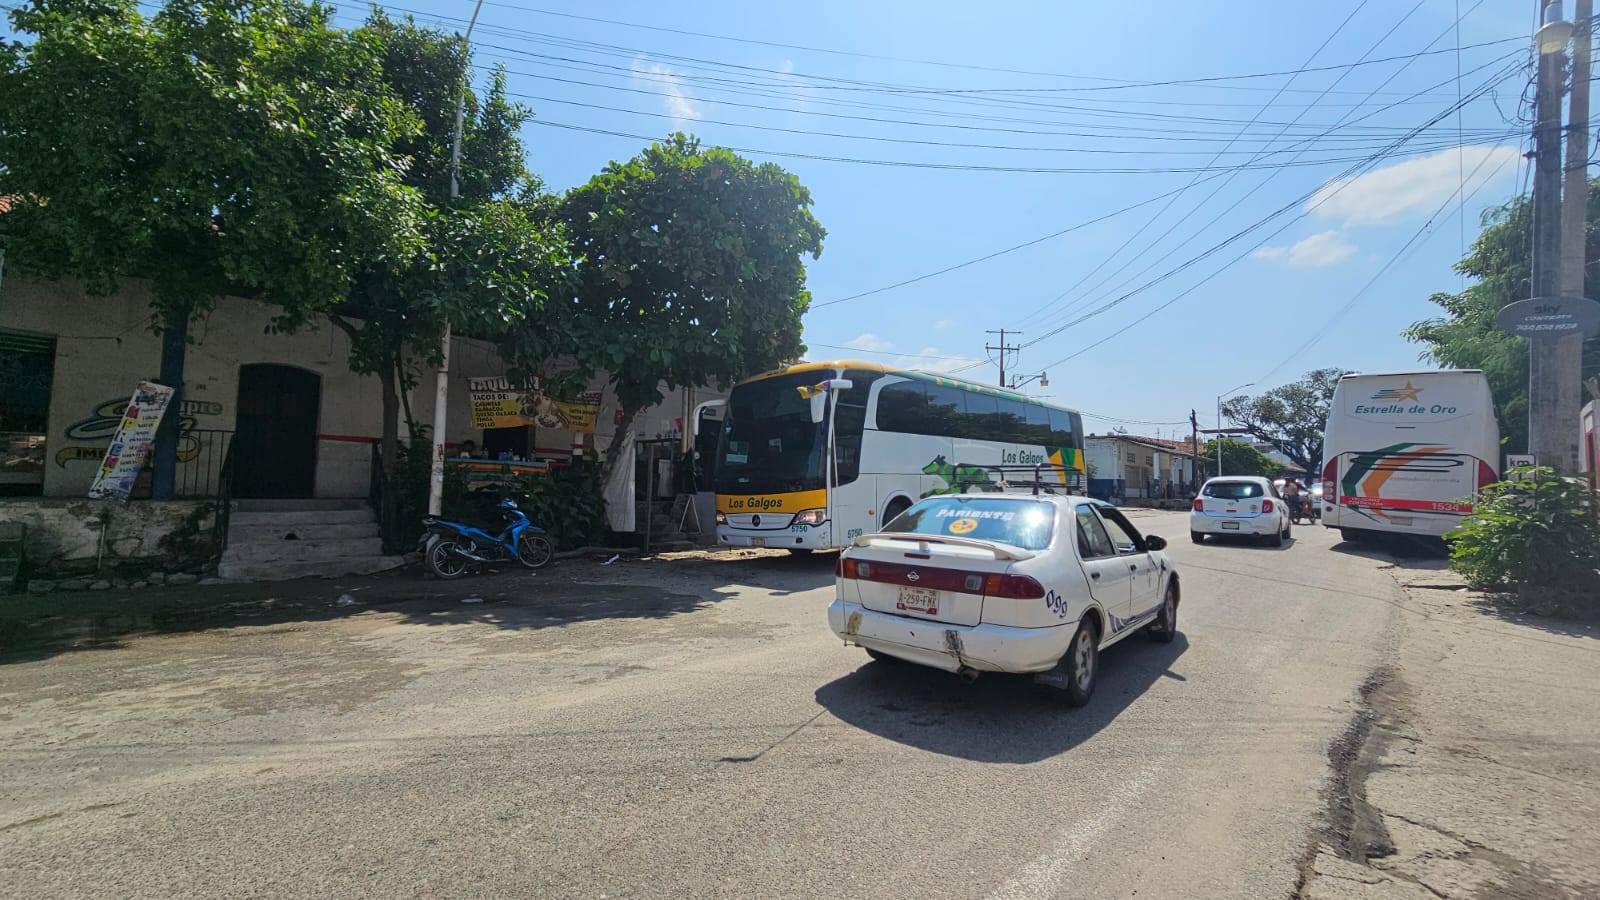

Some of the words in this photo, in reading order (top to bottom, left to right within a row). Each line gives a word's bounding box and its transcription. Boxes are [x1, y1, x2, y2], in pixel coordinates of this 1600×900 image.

[1535, 303, 1561, 314] sky
[473, 393, 496, 401] TACOS
[1355, 405, 1404, 414] Estrella
[1408, 405, 1425, 414] de
[1430, 404, 1457, 414] Oro
[1002, 449, 1017, 464] Los
[1019, 450, 1044, 464] Galgos
[728, 498, 744, 509] Los
[747, 497, 783, 510] Galgos
[1431, 502, 1459, 512] 1534
[791, 525, 808, 533] 5750
[1045, 589, 1068, 619] 099
